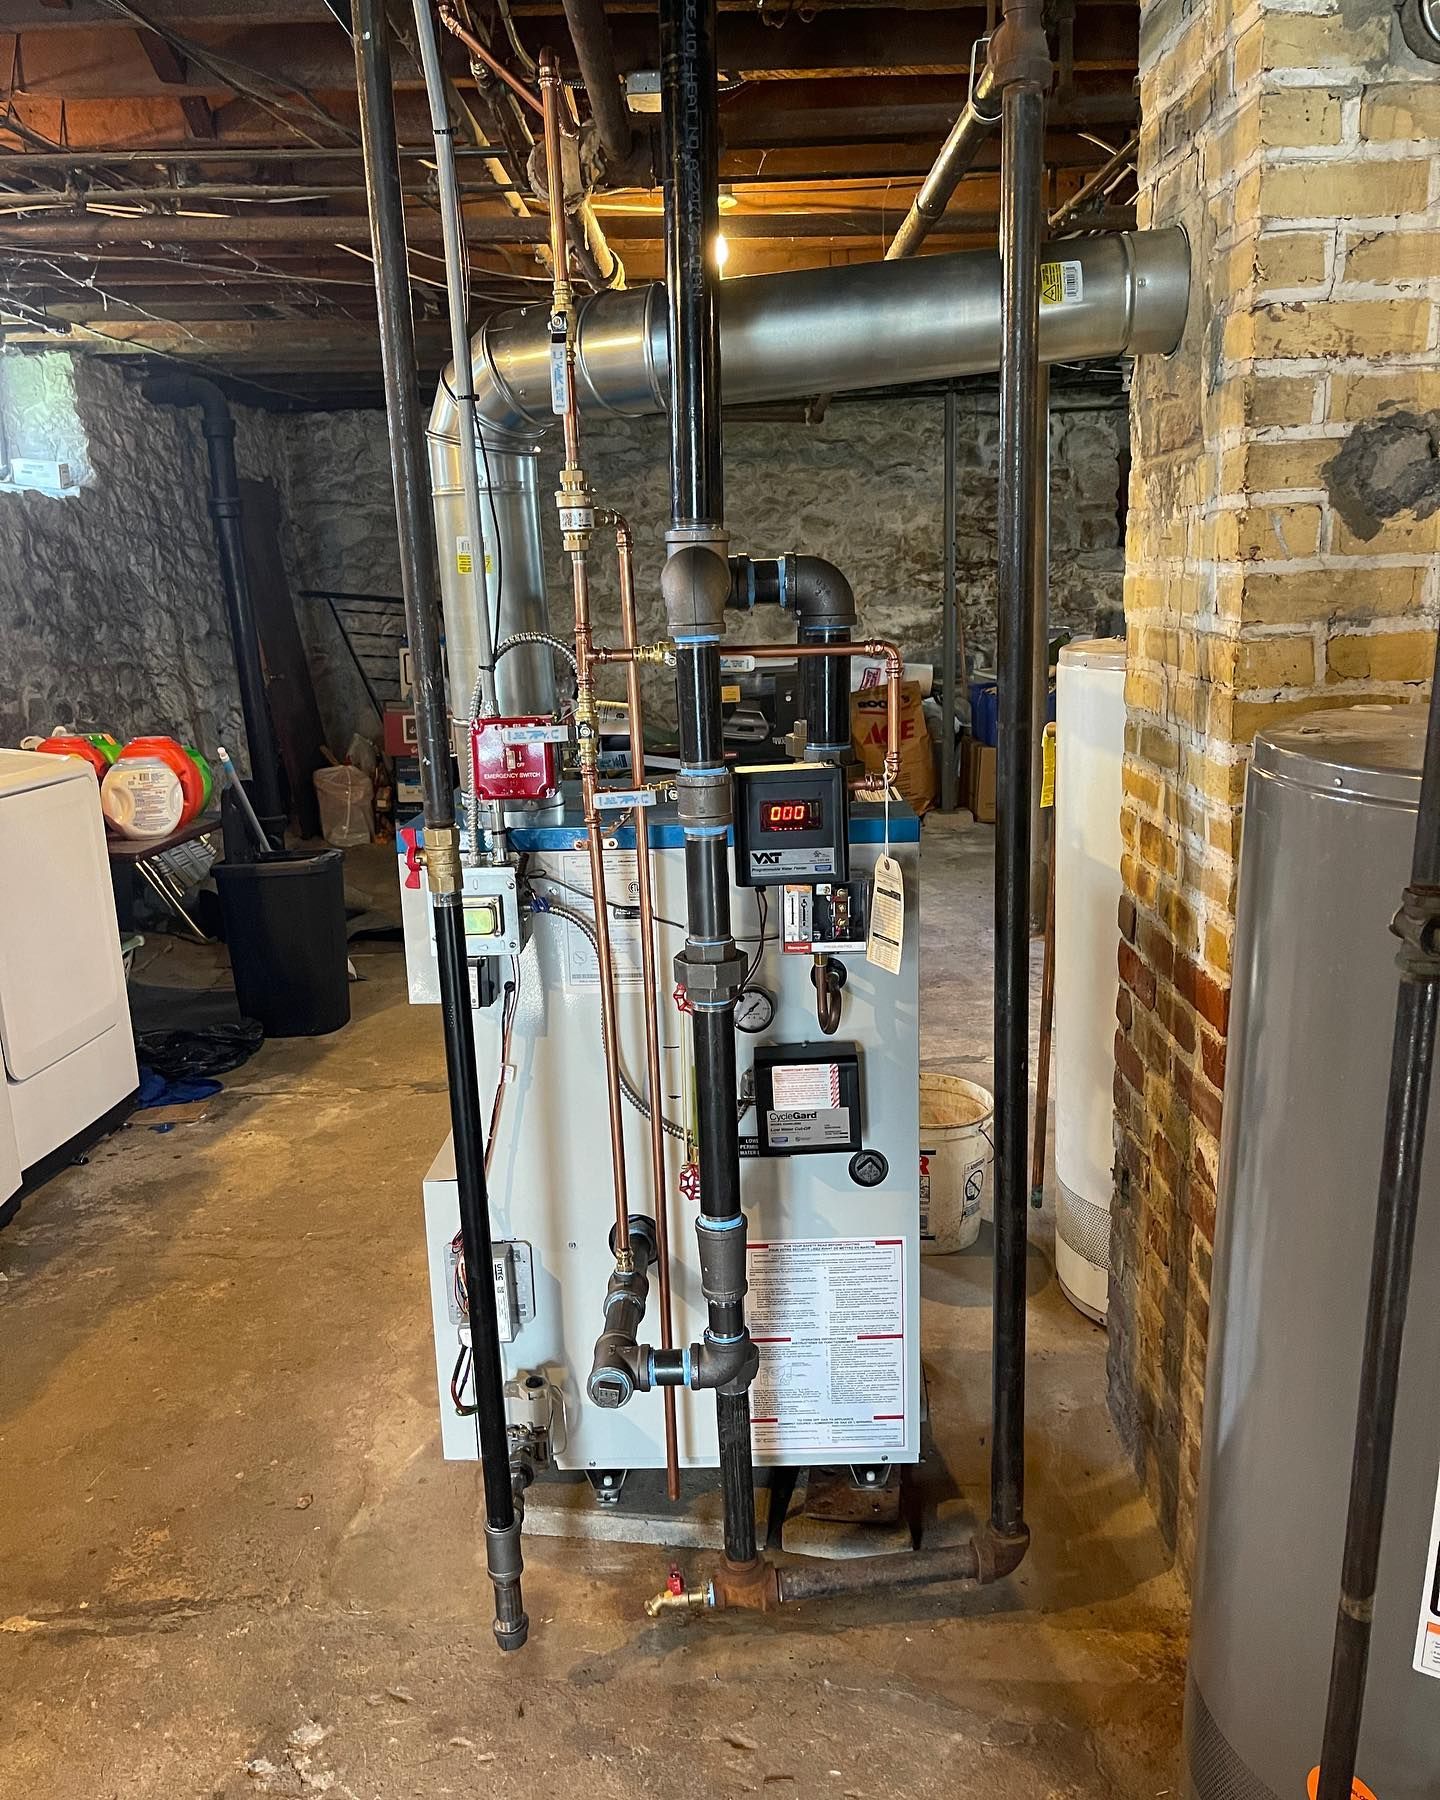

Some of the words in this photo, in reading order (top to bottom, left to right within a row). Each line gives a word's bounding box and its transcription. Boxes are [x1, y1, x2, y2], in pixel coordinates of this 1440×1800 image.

[483, 772, 518, 780] EMERGENCY
[770, 805, 805, 821] 000
[769, 1111, 818, 1123] CycleGard
